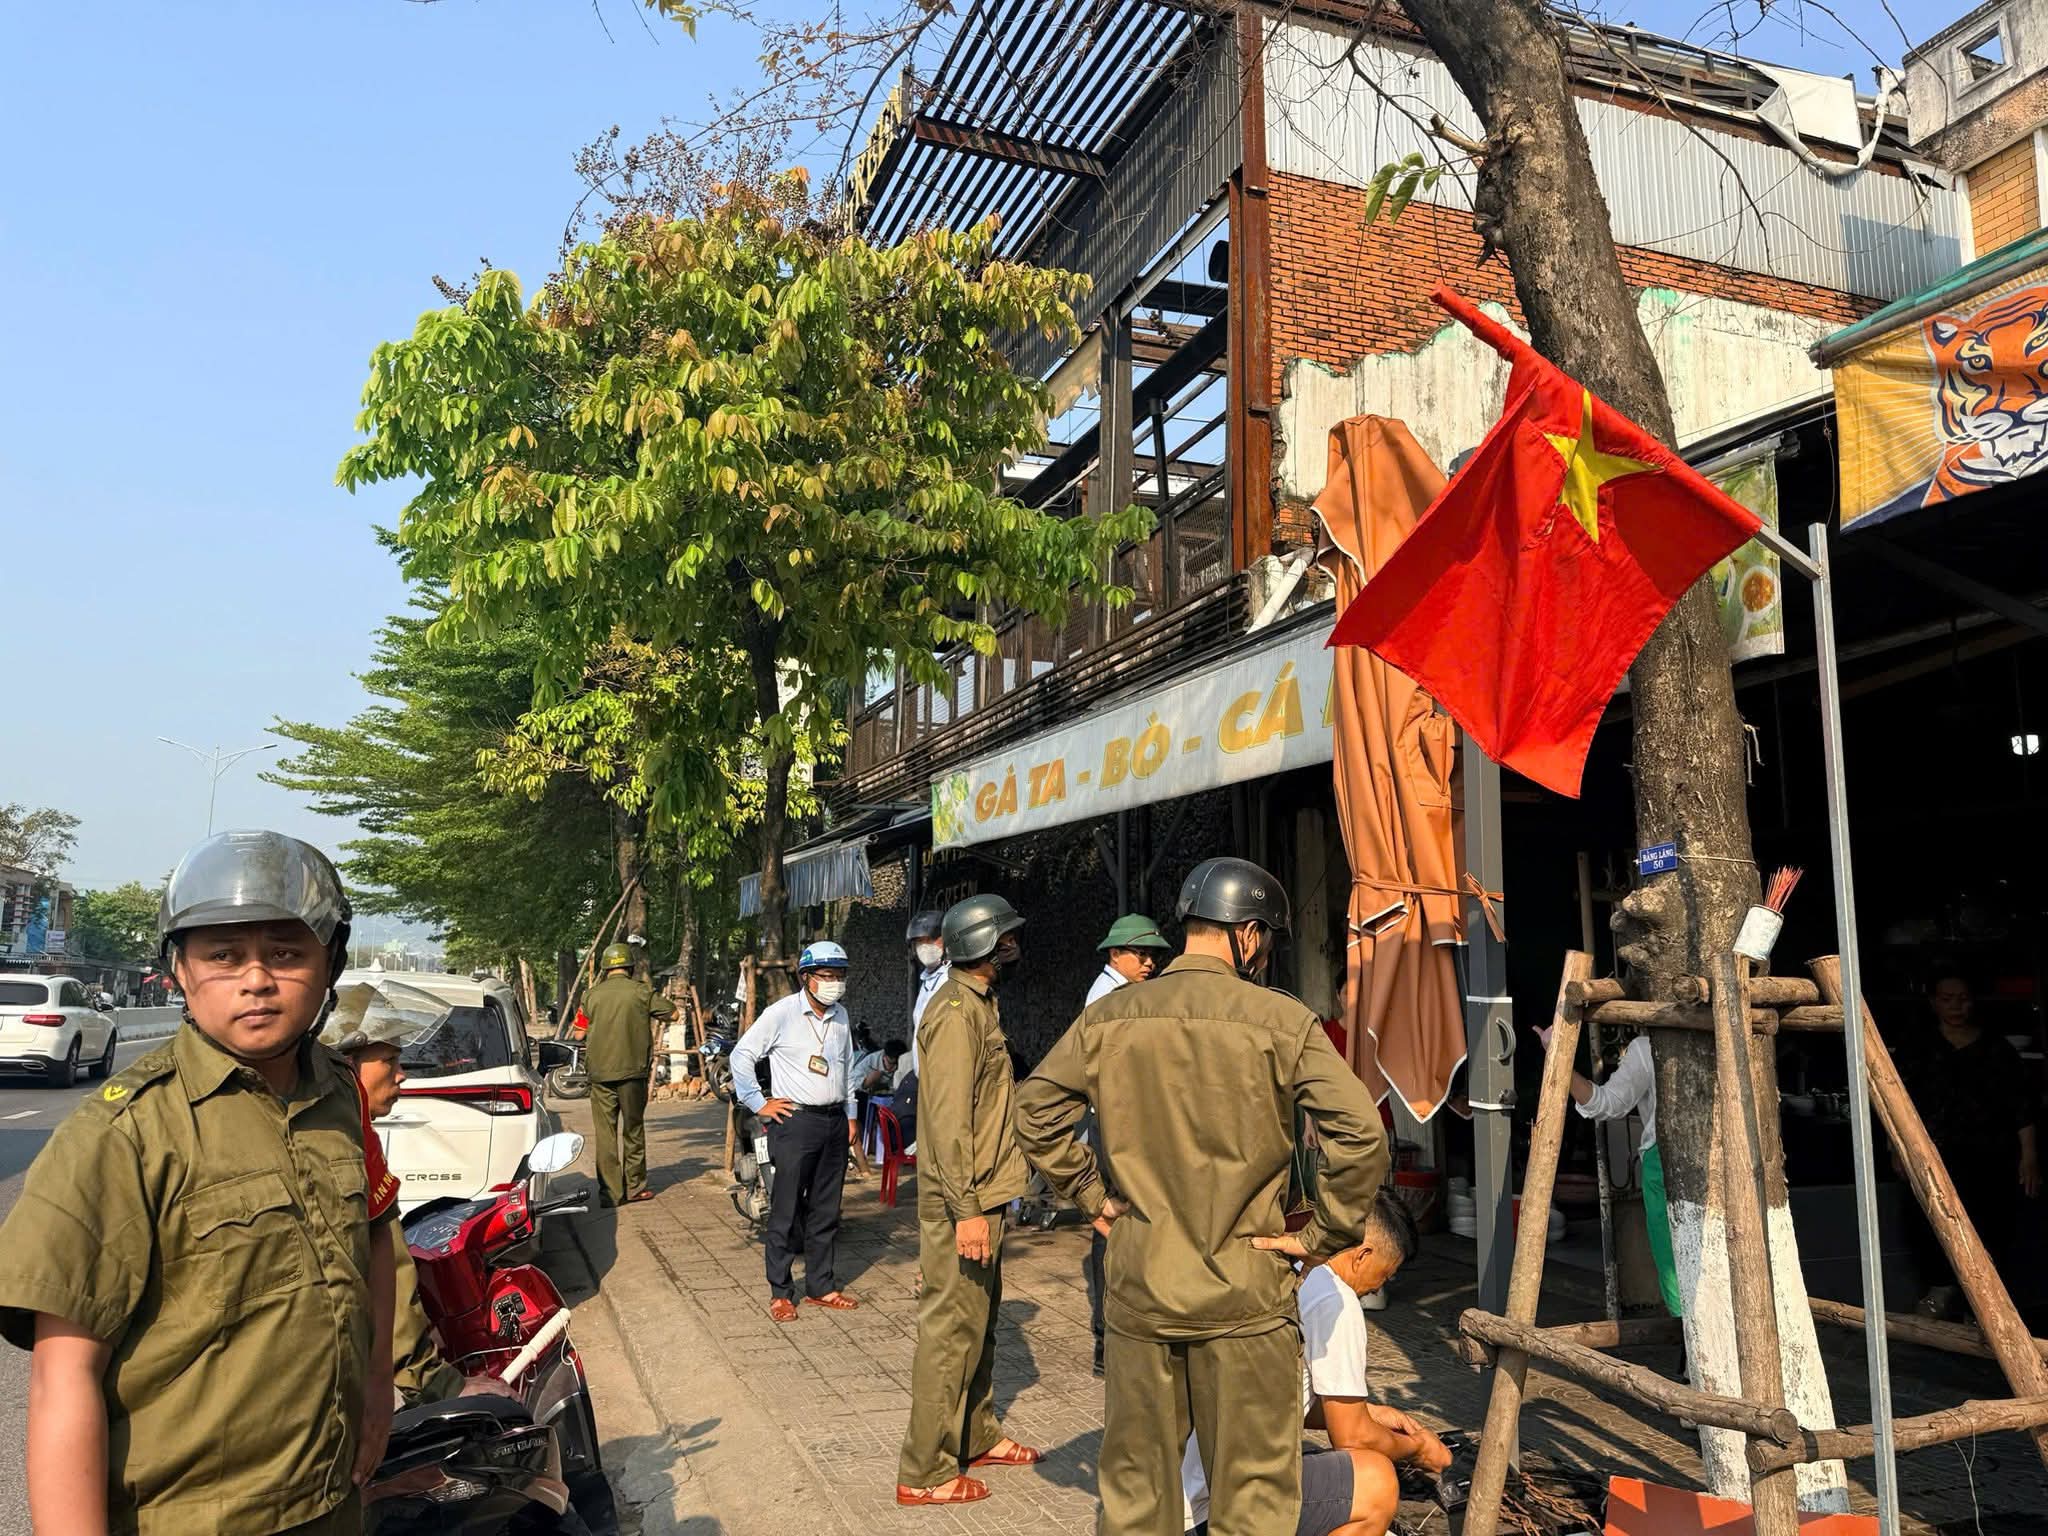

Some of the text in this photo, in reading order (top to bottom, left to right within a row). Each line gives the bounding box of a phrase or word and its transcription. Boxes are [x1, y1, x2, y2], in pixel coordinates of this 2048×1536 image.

[974, 761, 1018, 824] GÀ
[1028, 756, 1067, 811] TA
[1077, 770, 1091, 785] -
[1099, 711, 1171, 791] BÒ
[1183, 735, 1202, 754] -
[1218, 660, 1304, 755] CÁ
[1653, 859, 1664, 870] 50
[405, 1173, 462, 1182] CROSS
[373, 1183, 389, 1205] AN
